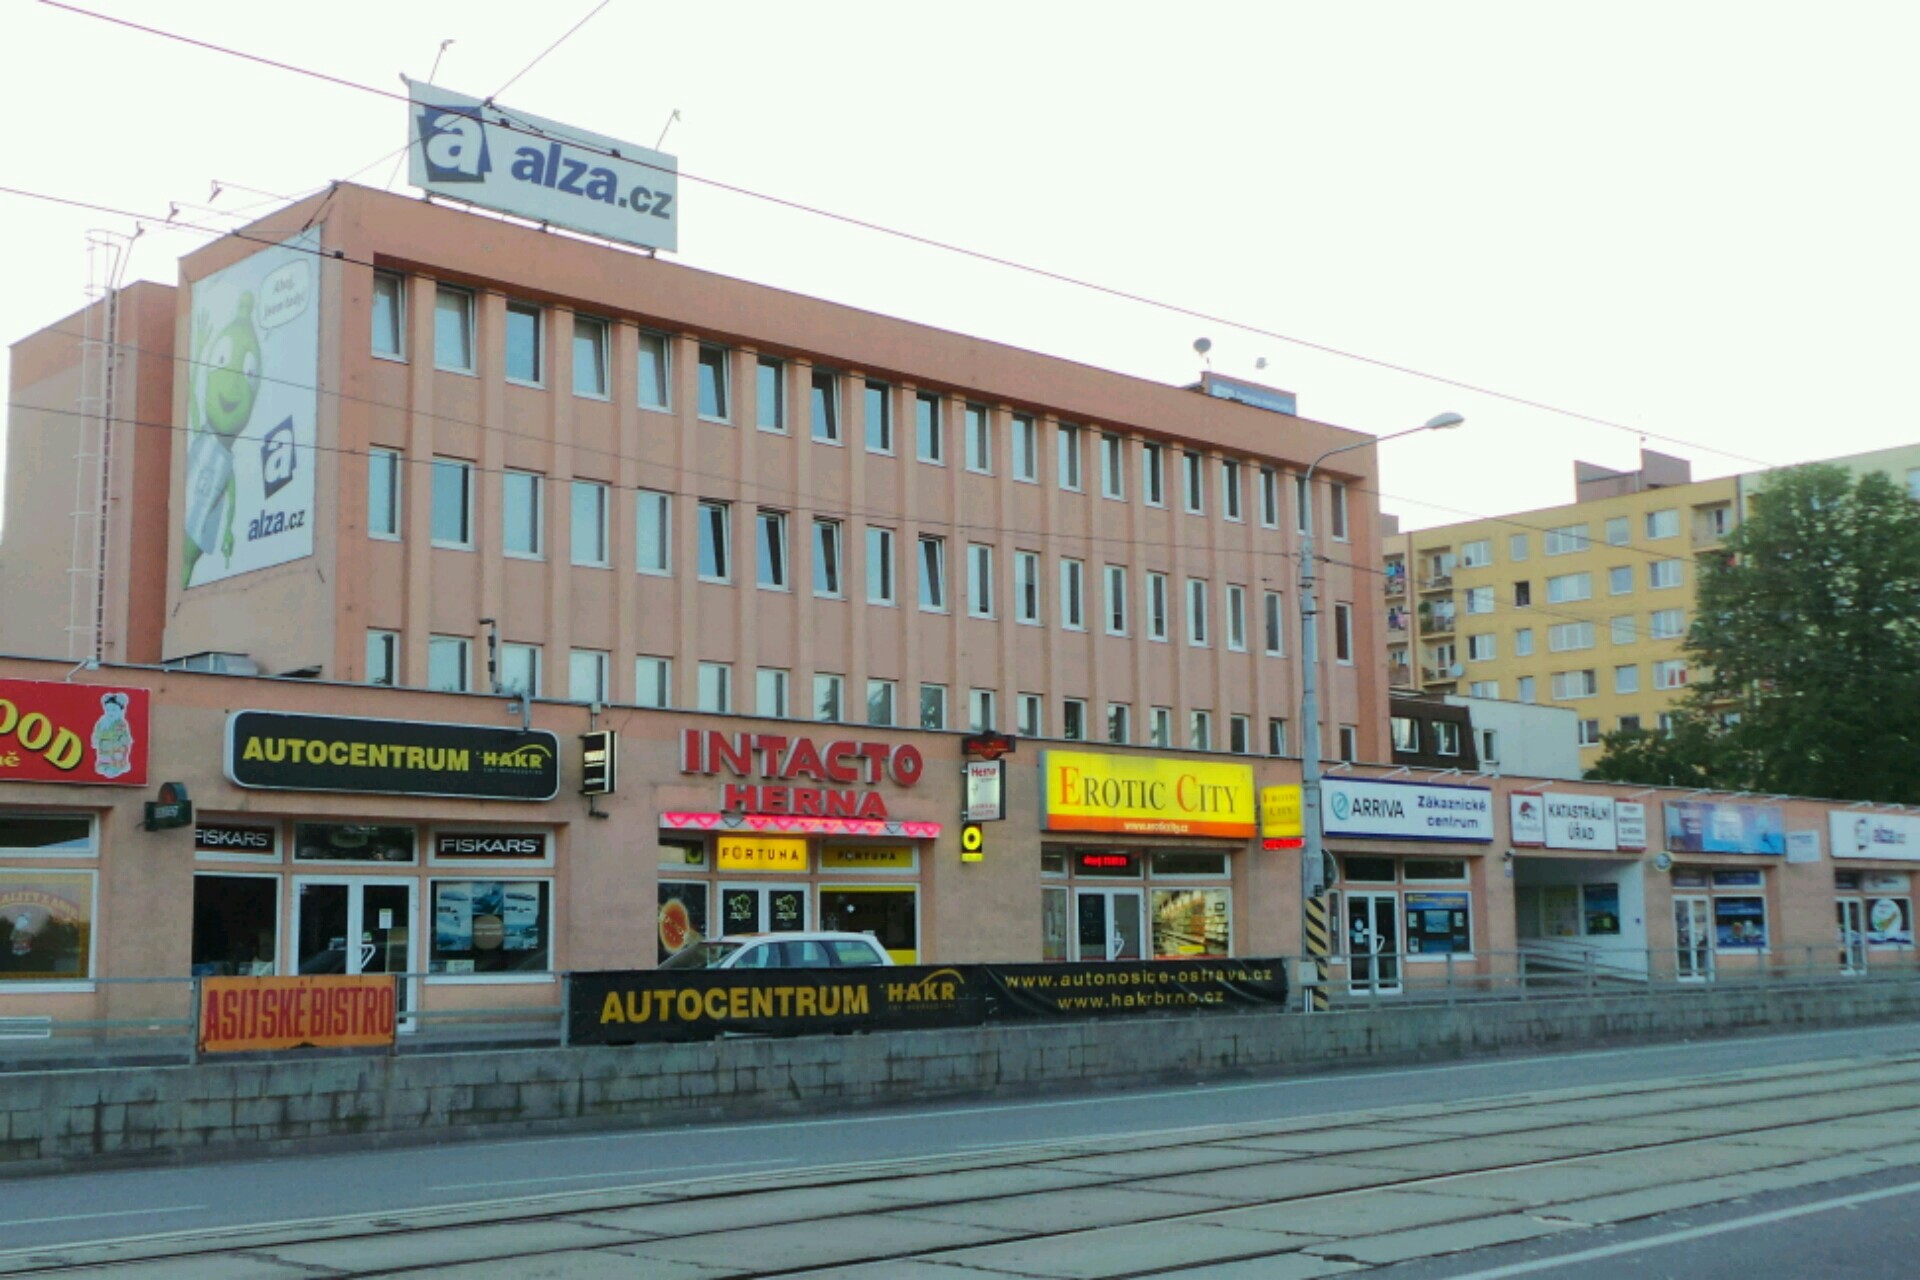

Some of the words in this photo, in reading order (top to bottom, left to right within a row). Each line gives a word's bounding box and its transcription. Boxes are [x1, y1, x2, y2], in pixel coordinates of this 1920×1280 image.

[510, 143, 673, 220] alza.cz
[248, 509, 305, 541] alza.cz
[242, 736, 470, 771] AUTOCENTRUM
[483, 751, 543, 769] HAKR
[680, 728, 924, 787] INTACTO
[721, 783, 889, 819] HERNA
[1351, 797, 1406, 819] ARRIVA
[1417, 795, 1487, 812] Zákaznické
[1427, 814, 1479, 828] centrum
[1548, 802, 1611, 821] KATASTRÁLNÍ
[195, 828, 268, 847] FISKARS
[1567, 821, 1595, 840] ÚŘAD
[440, 839, 538, 853] FISKARS
[722, 845, 799, 861] FORTUNA
[837, 849, 897, 861] FORTUNA
[205, 980, 306, 1042] ASIJSKÉ
[309, 986, 395, 1038] BISTRO
[600, 984, 870, 1024] AUTOCENTRUM
[887, 982, 957, 1002] HAKR
